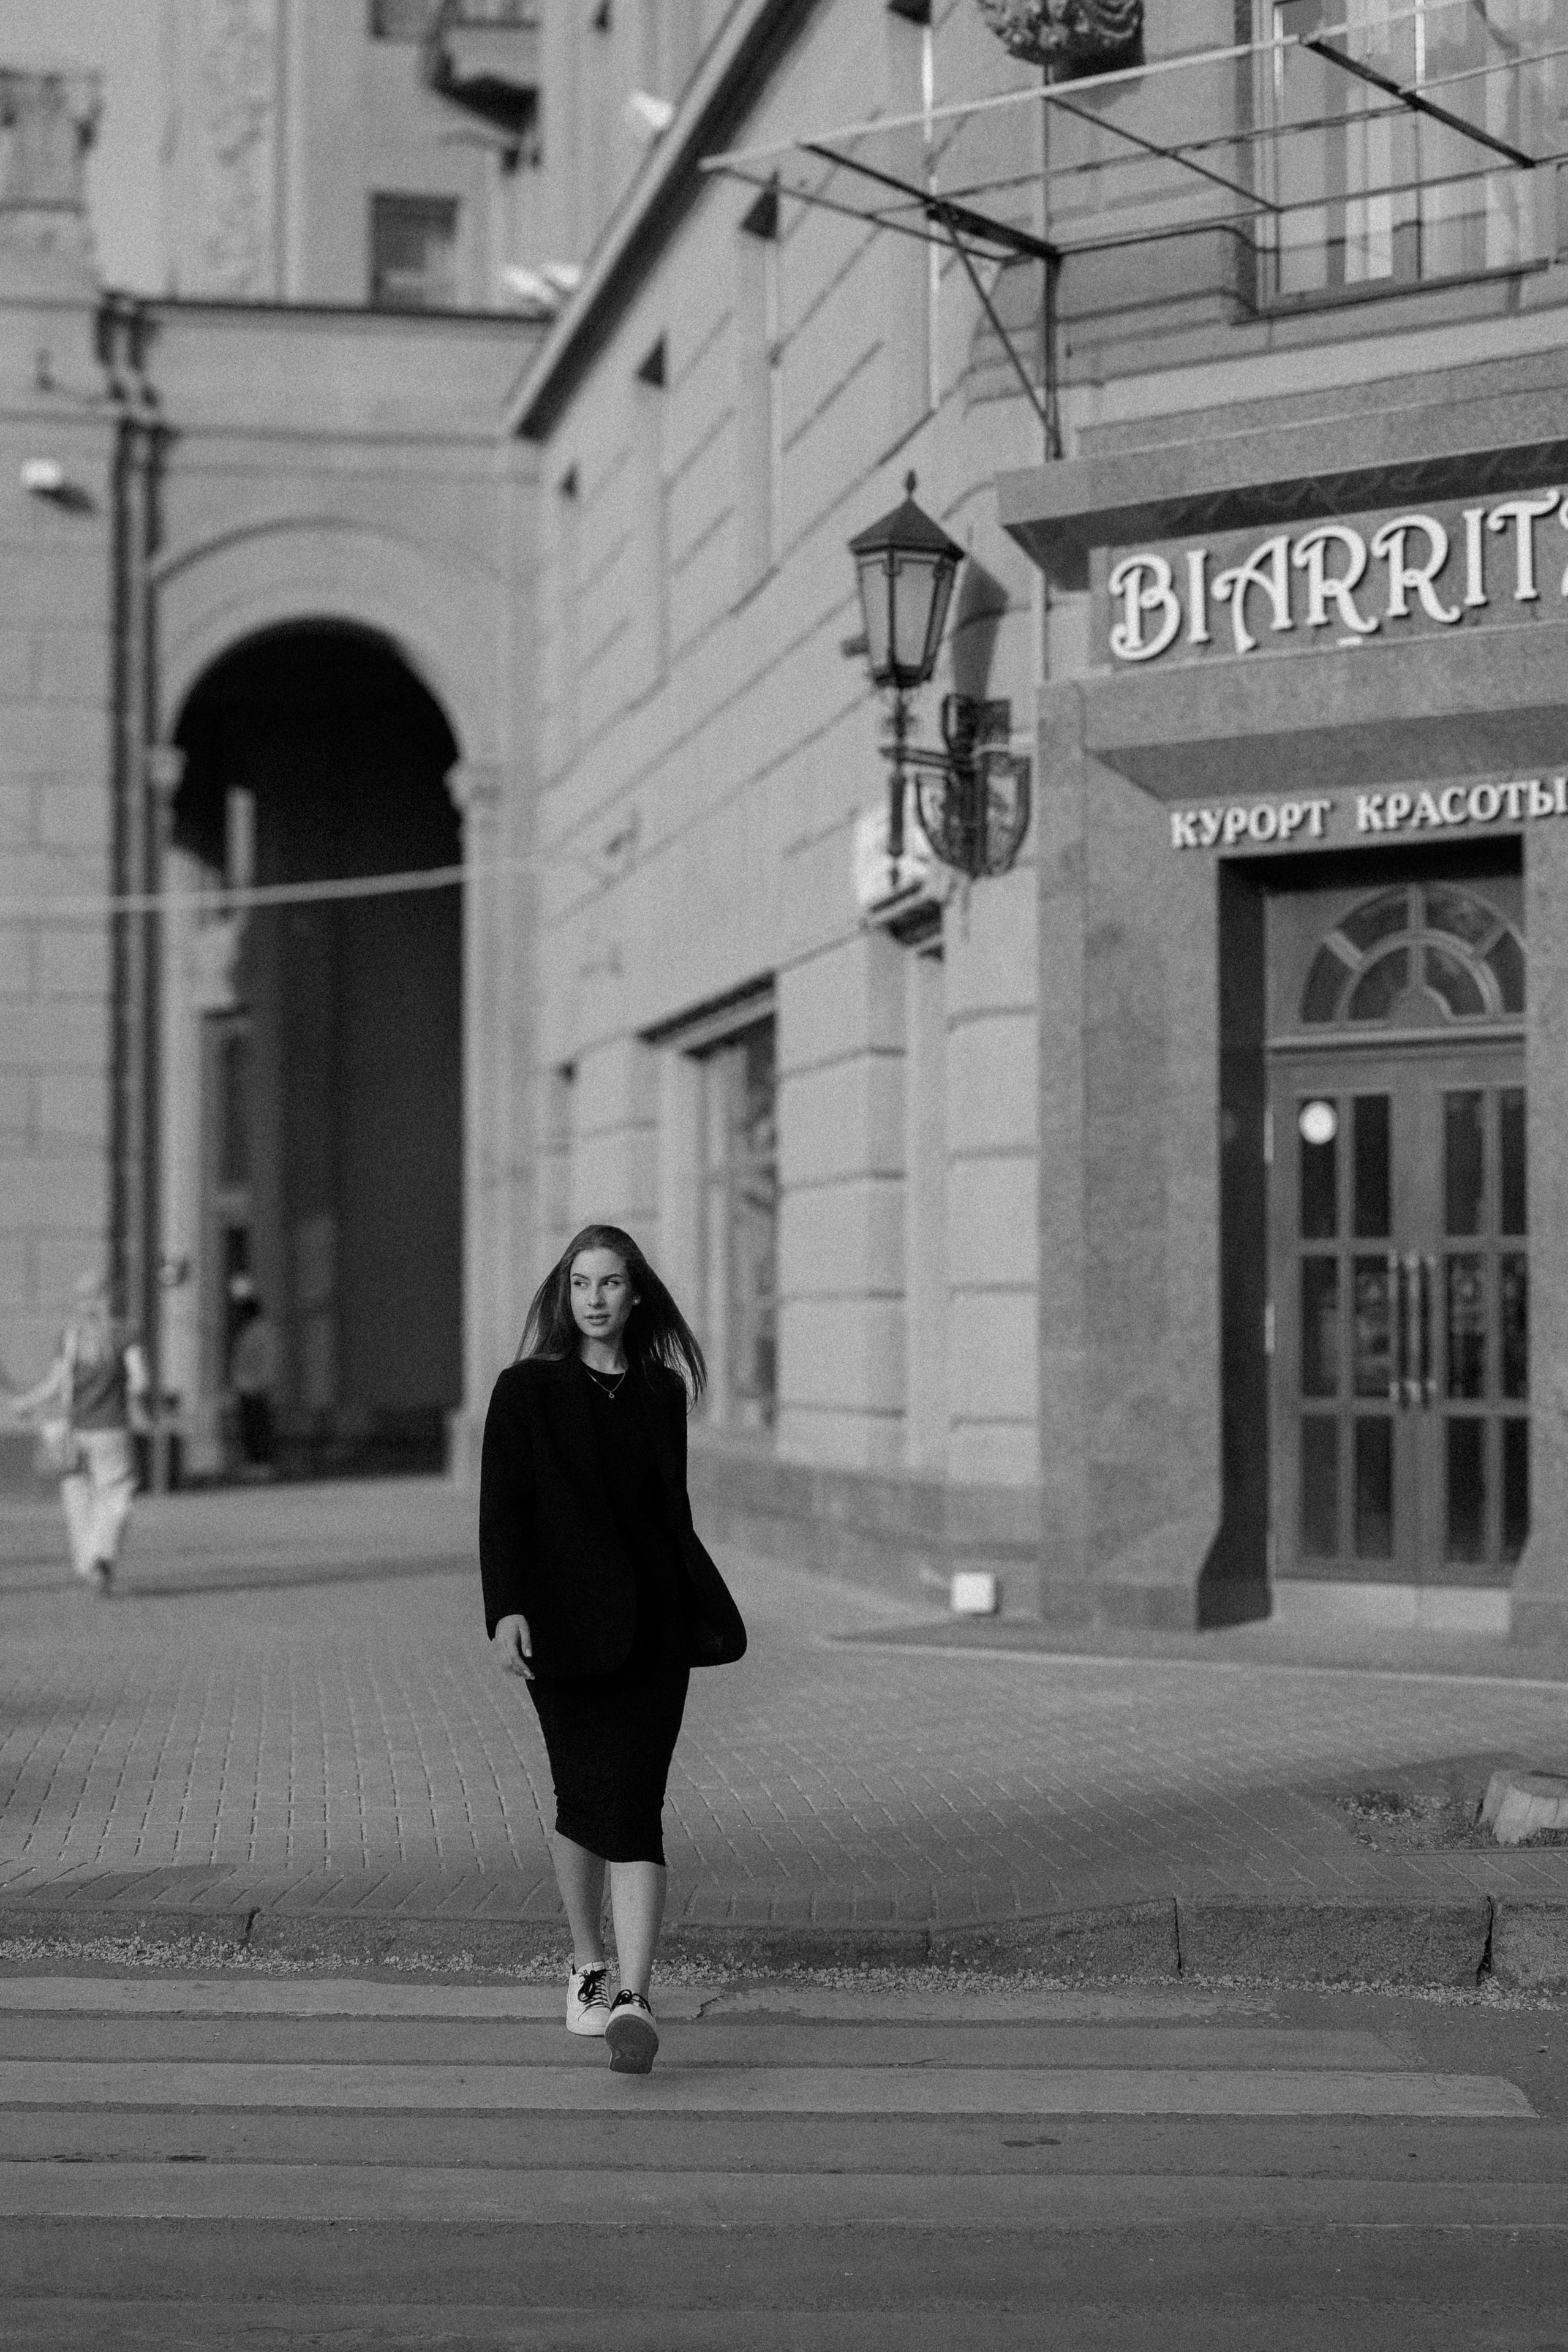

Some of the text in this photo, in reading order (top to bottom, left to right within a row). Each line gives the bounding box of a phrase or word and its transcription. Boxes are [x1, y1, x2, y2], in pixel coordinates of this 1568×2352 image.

[1109, 489, 1568, 660] BIARRIT
[1170, 777, 1568, 849] КУРОРТ КРАСОТЫ
